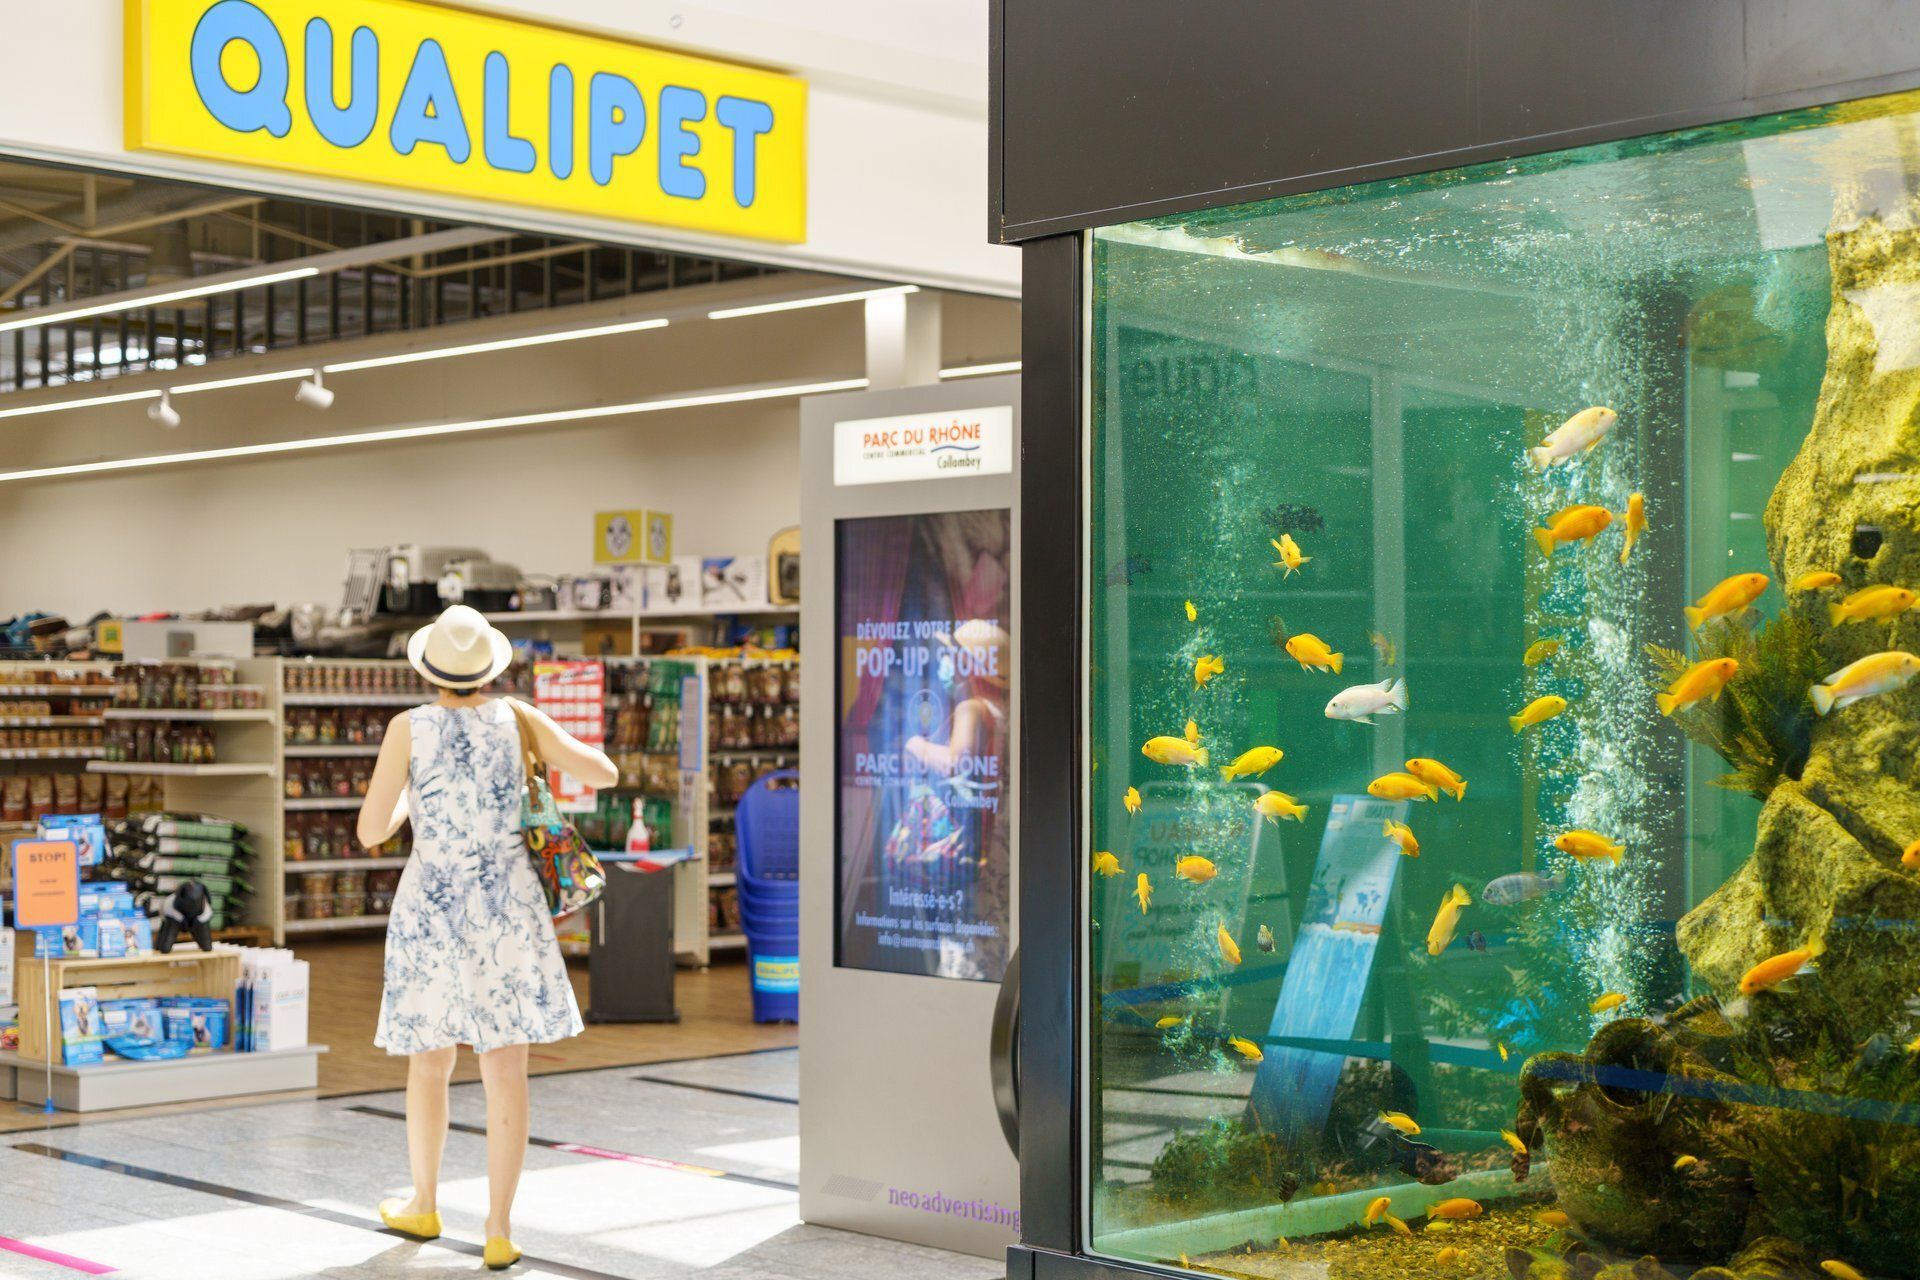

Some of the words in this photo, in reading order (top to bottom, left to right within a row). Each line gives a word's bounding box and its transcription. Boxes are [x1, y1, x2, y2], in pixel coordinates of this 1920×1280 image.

[190, 0, 774, 208] QUALIPET
[863, 431, 898, 449] PARC
[904, 428, 924, 445] DU
[929, 419, 981, 445] RHÔNE
[937, 453, 981, 470] Collombey
[857, 618, 910, 640] DÉVOILEZ
[913, 620, 952, 639] VOTRE
[856, 645, 929, 677] POP-UP
[936, 645, 999, 677] STORE
[855, 753, 900, 776] PARC
[903, 753, 928, 774] DU
[931, 749, 998, 777] HÔNE
[29, 851, 67, 864] STOP!
[856, 911, 898, 929] Informations
[900, 918, 912, 929] sur
[913, 915, 924, 931] les
